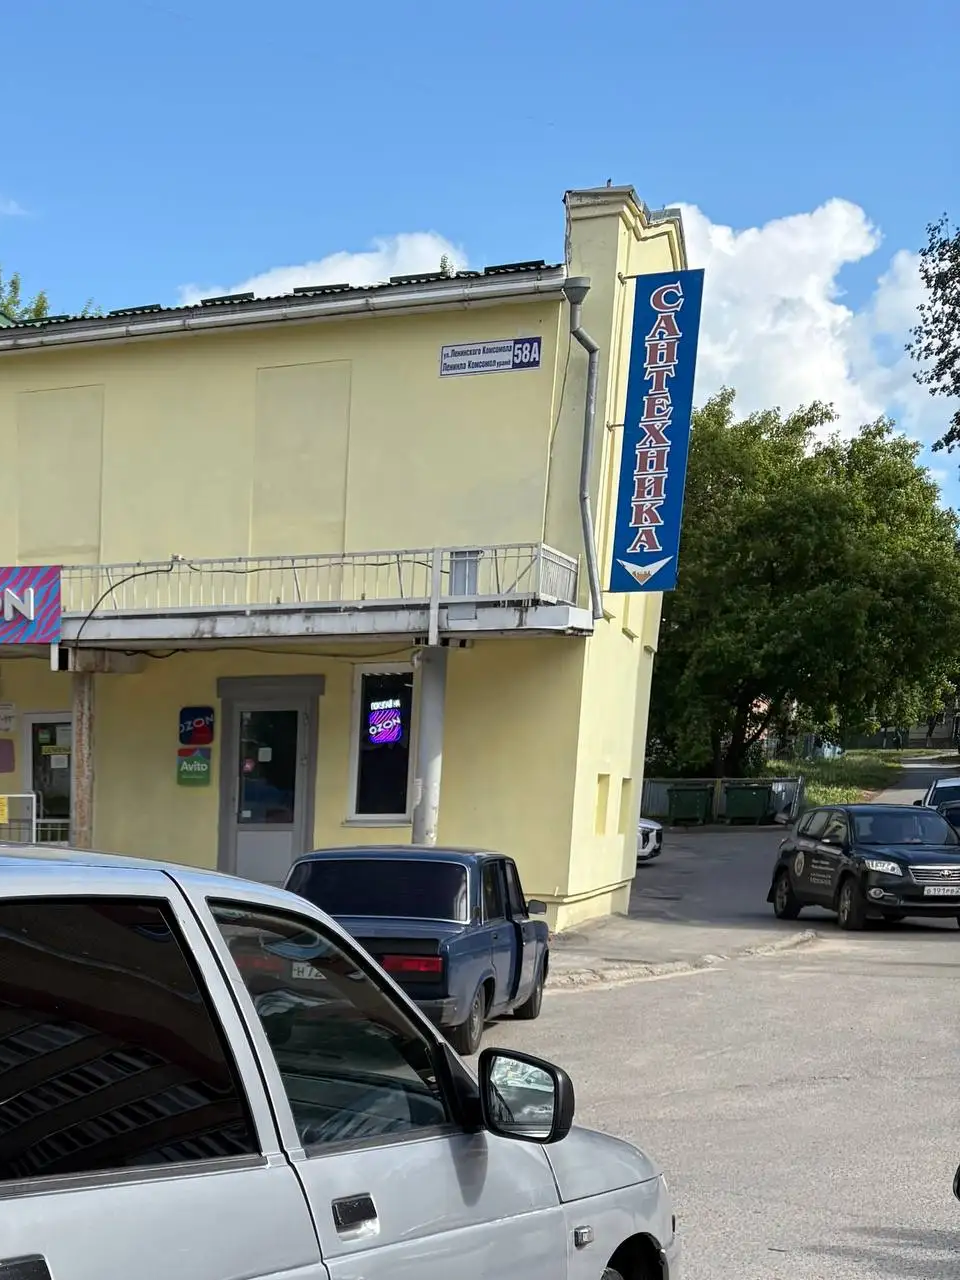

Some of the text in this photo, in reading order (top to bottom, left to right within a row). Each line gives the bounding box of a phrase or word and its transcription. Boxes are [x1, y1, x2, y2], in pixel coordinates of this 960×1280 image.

[482, 345, 512, 354] Комсомола
[513, 342, 539, 363] 58А
[467, 360, 497, 369] Комсомол
[628, 281, 684, 552] САНТЕХНИКА
[369, 716, 401, 735] OZON
[179, 760, 209, 772] Avito
